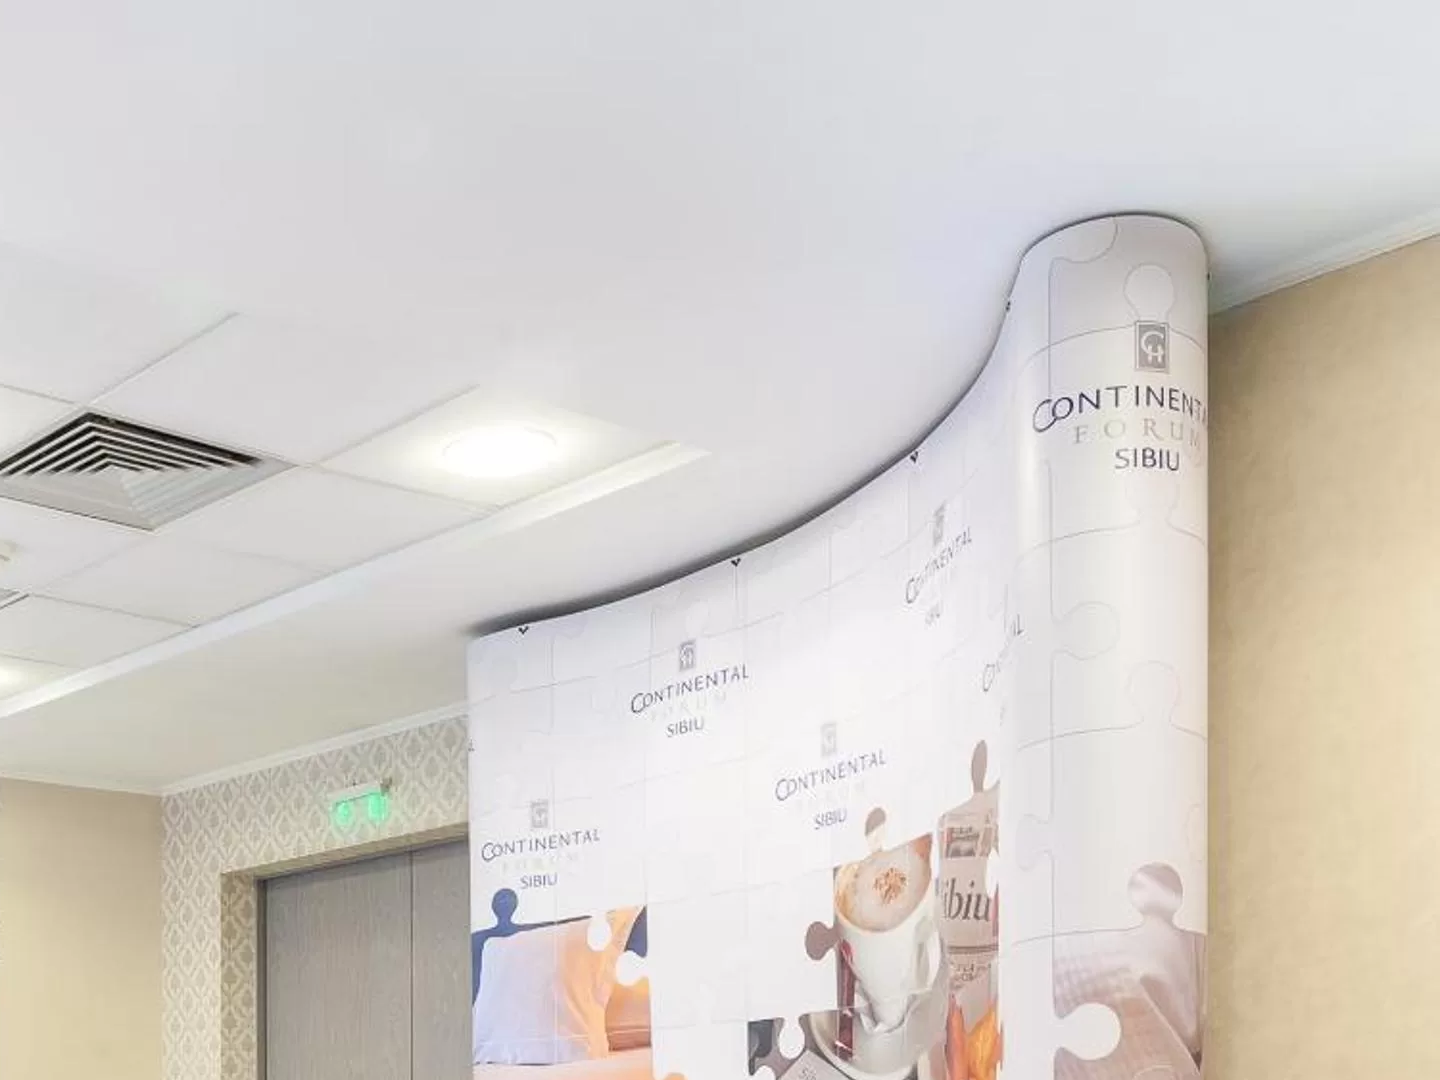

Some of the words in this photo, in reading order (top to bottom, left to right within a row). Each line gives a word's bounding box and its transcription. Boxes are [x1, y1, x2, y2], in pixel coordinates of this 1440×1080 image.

[1032, 384, 1208, 433] CONTINENT
[1114, 446, 1181, 472] SIBIU
[631, 664, 749, 714] CONTINENTAL
[666, 716, 705, 738] SIBIU
[775, 748, 887, 801] CONTINENTAL
[482, 829, 600, 862] CONTINENTAL
[520, 872, 558, 890] SIBIU
[943, 876, 992, 922] ibiu
